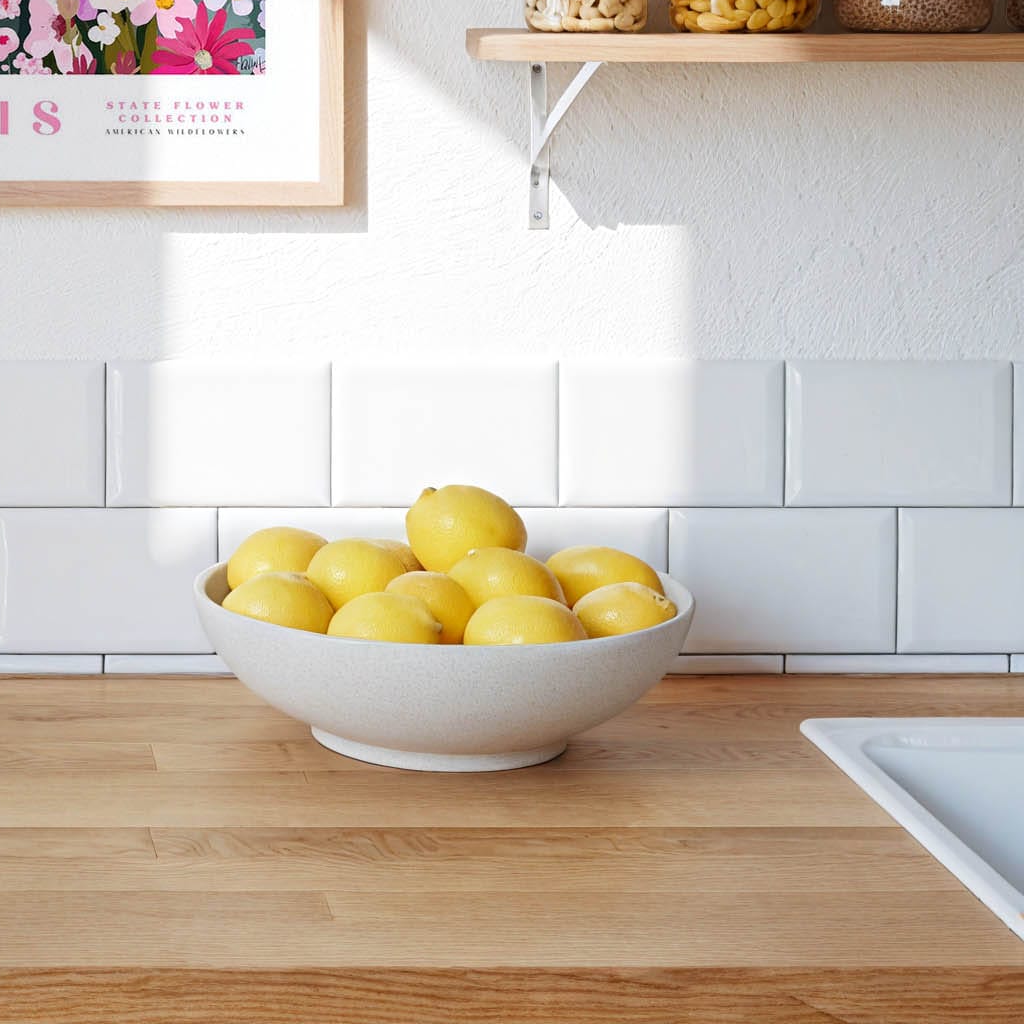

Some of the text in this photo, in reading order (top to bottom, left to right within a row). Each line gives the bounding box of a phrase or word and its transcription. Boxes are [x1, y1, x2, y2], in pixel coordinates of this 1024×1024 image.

[105, 101, 245, 110] STATE FLOWER
[118, 113, 233, 123] COLLECTION
[104, 128, 246, 136] AMERICAN WILDFLOWERS
